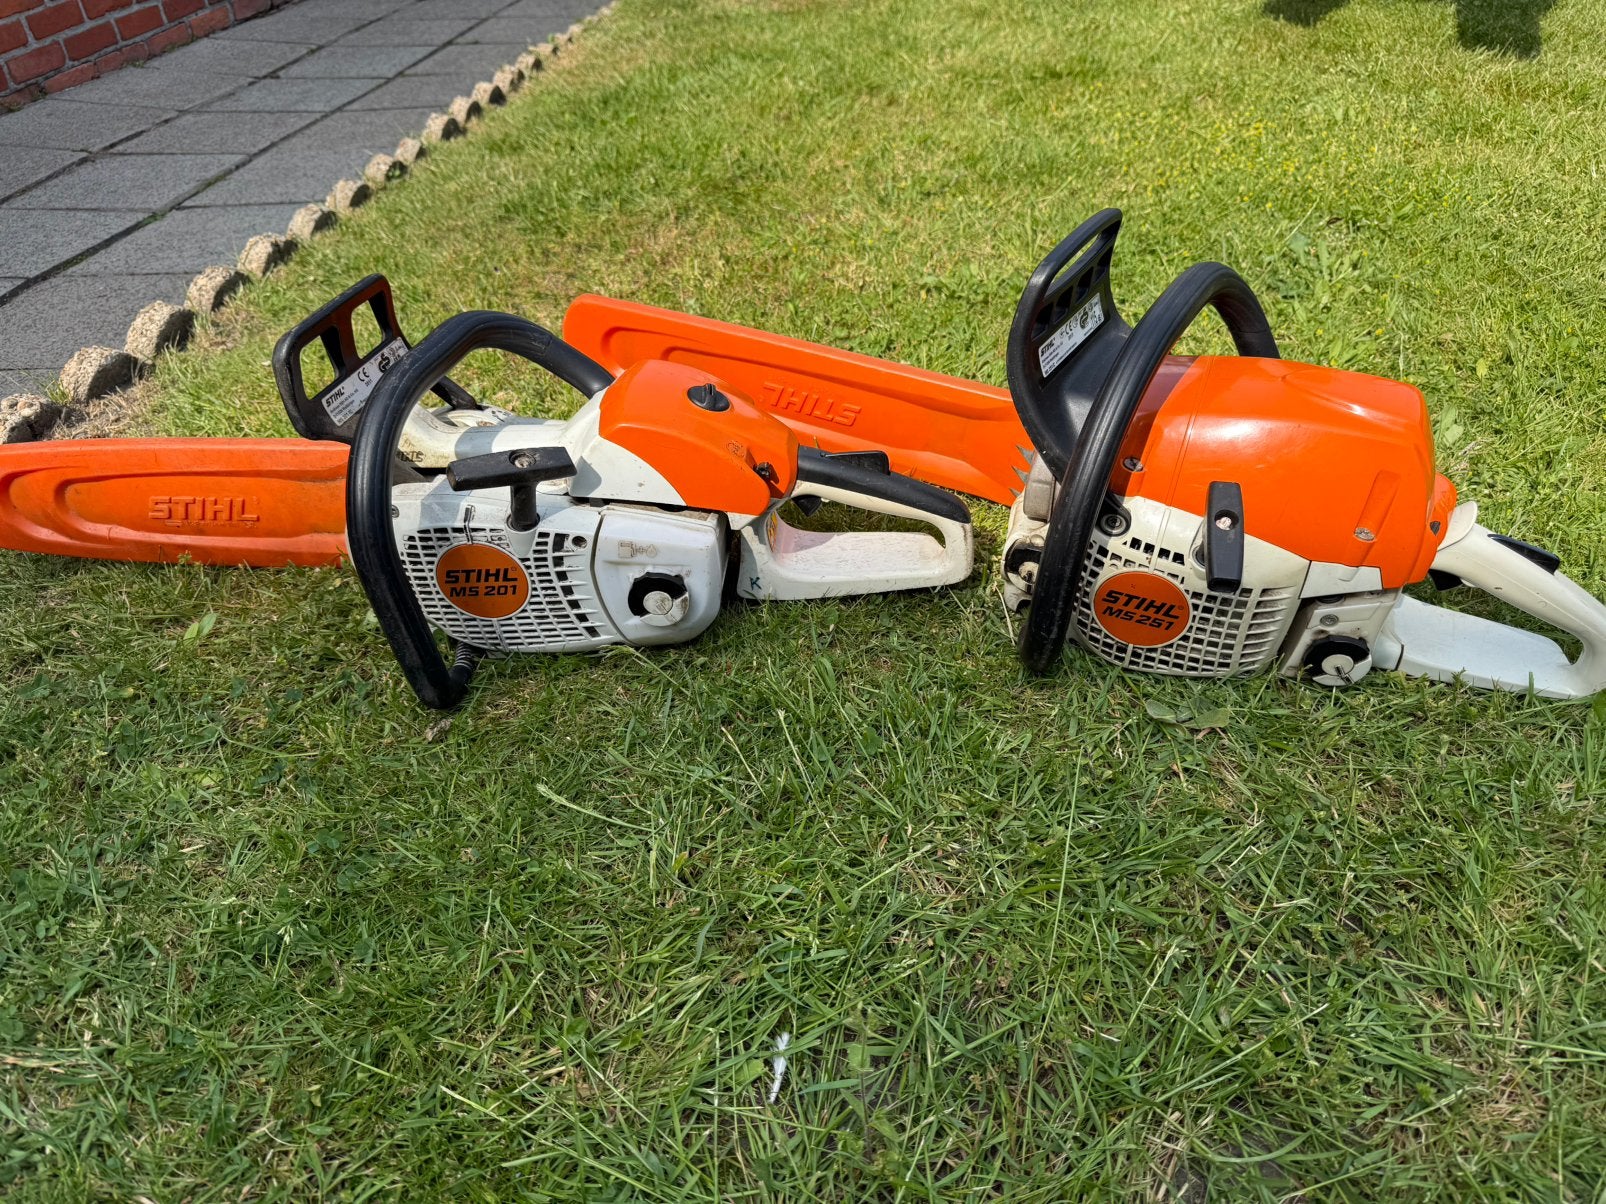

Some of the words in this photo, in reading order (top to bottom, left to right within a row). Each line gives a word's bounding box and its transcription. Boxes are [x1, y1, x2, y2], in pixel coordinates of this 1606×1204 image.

[325, 388, 344, 407] STIHL
[763, 381, 862, 427] STIHL
[149, 496, 260, 522] STIHL
[445, 568, 518, 584] STIHL
[749, 576, 762, 591] K
[450, 586, 480, 597] MS
[484, 585, 517, 596] 201
[1101, 589, 1180, 620] STIHL
[1102, 606, 1136, 621] MS
[1134, 614, 1175, 631] 251
